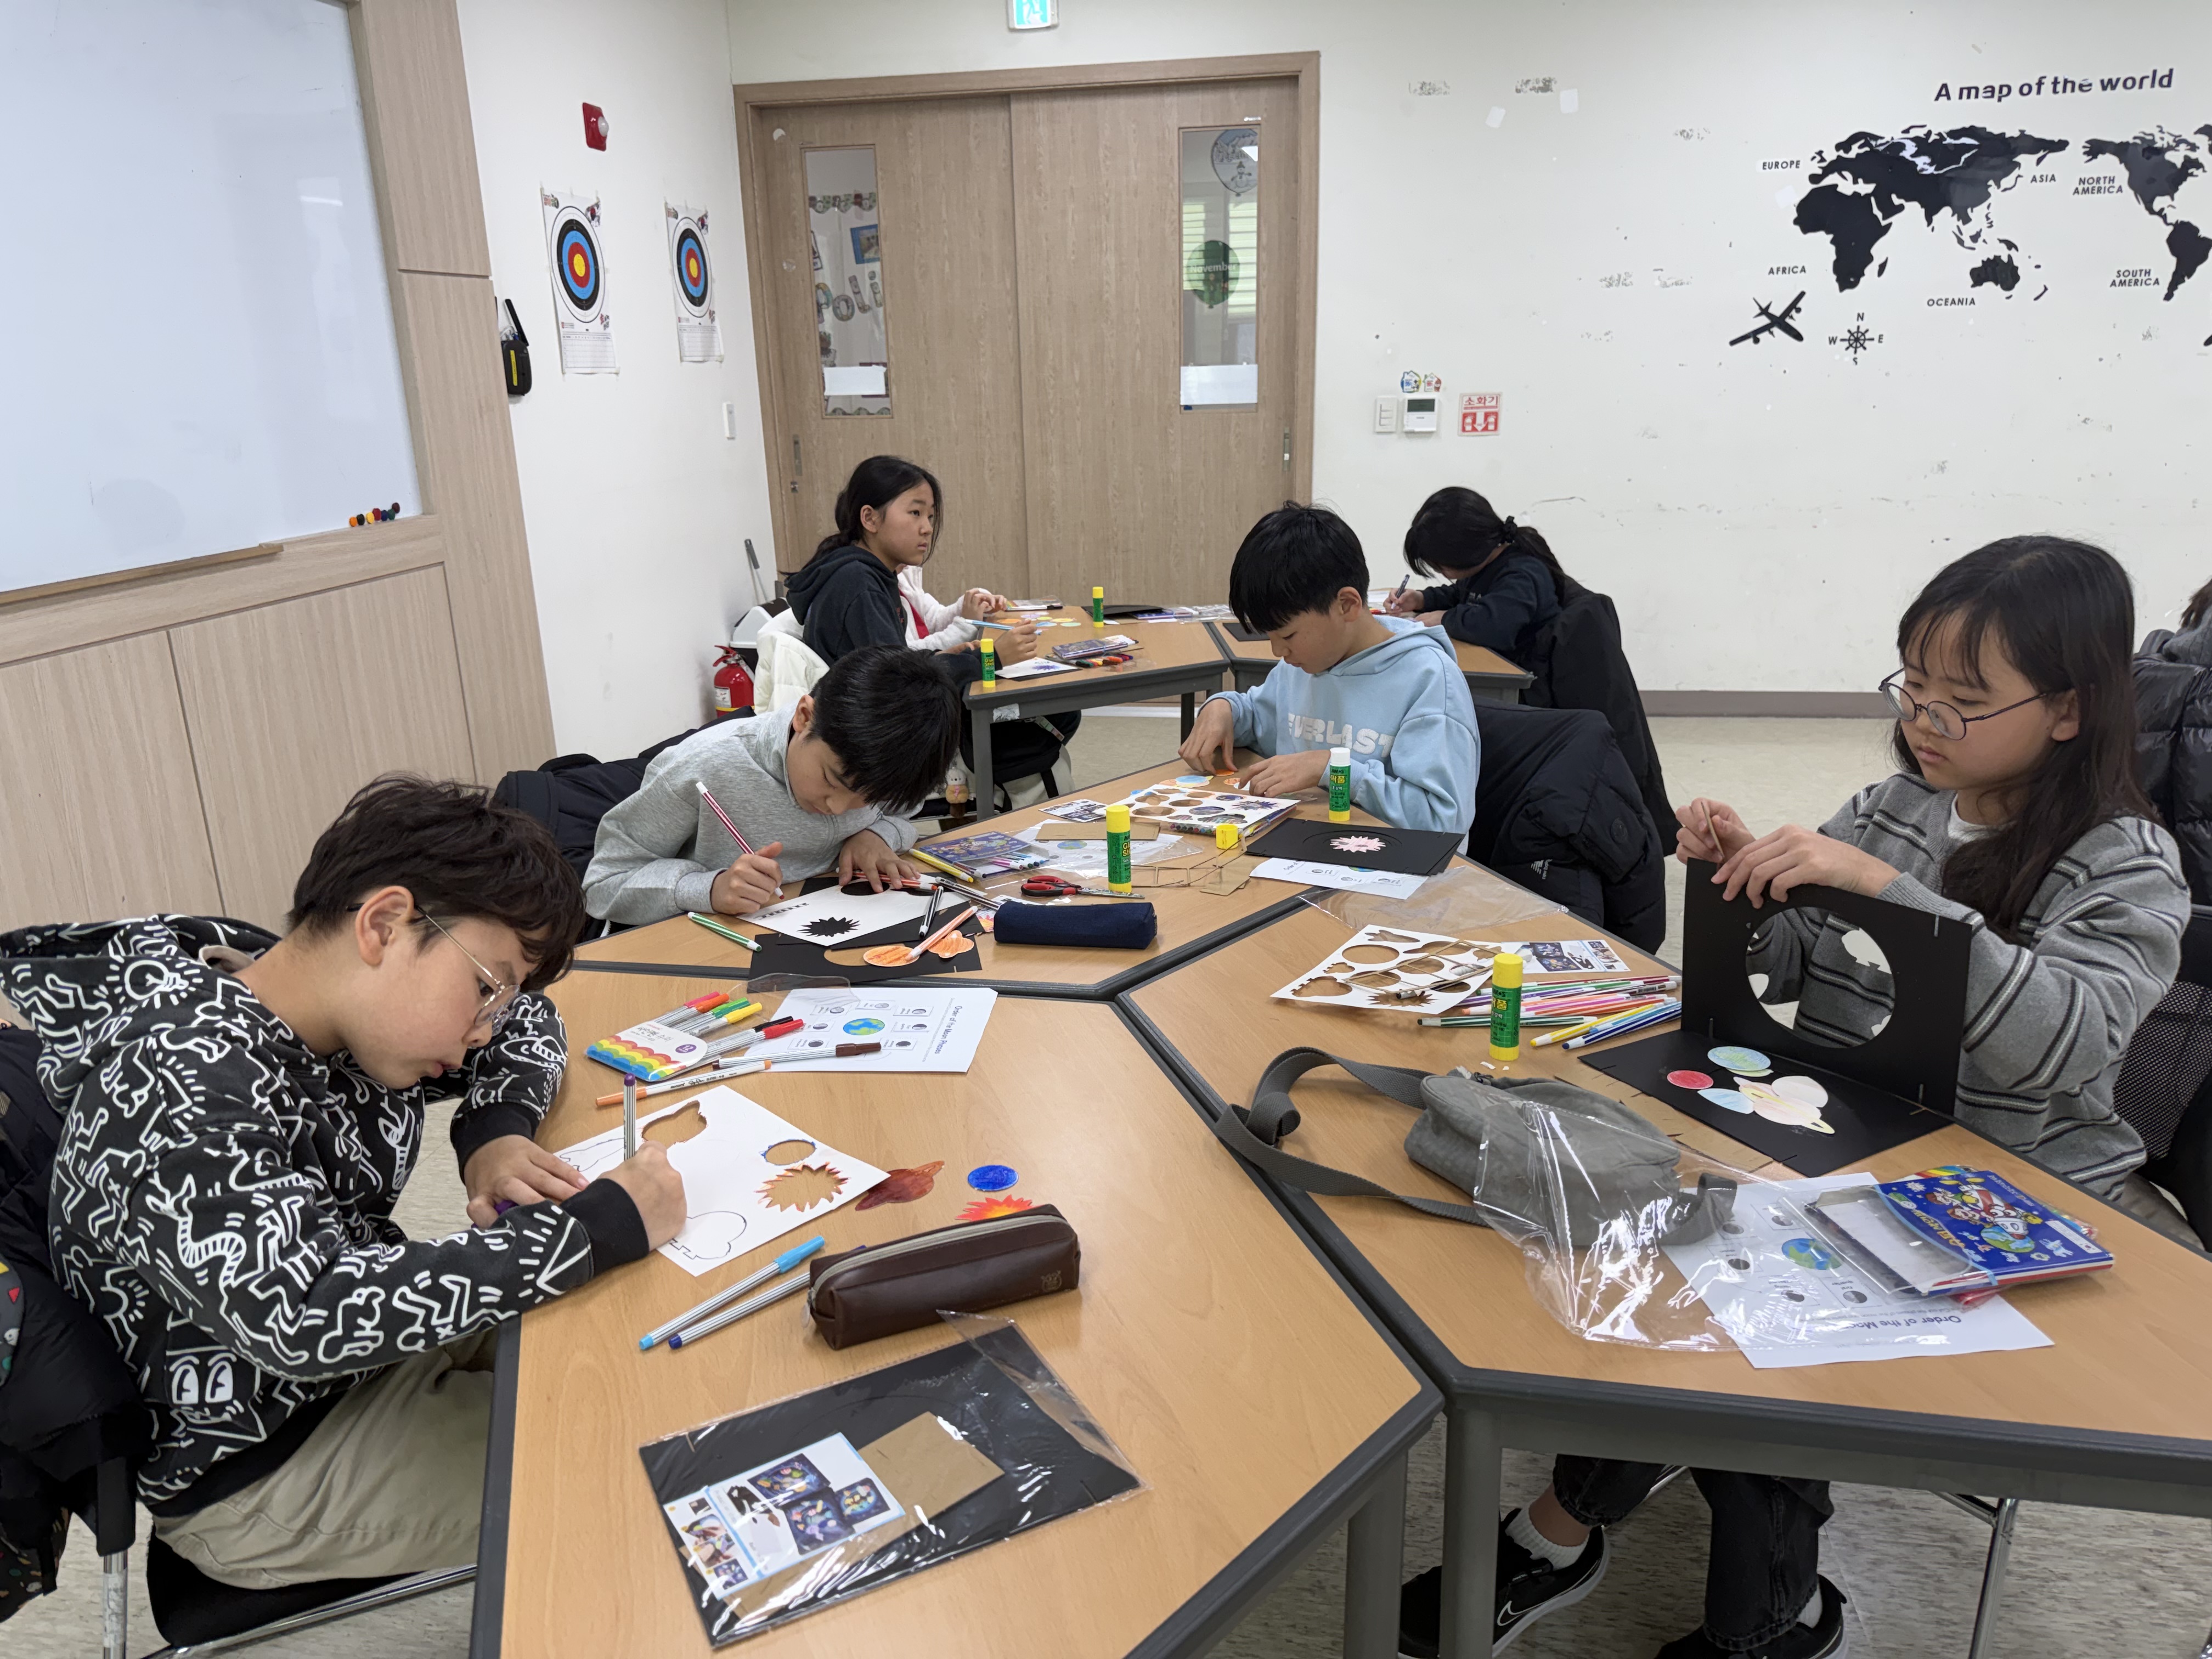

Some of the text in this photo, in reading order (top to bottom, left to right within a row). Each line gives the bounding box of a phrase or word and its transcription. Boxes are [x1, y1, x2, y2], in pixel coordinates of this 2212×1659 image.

[1934, 68, 2174, 103] A map of the world
[1762, 160, 1801, 170] EUROPE
[2030, 173, 2056, 183] ASIA
[2079, 176, 2116, 185] NORTH
[2073, 185, 2123, 195] AMERICA
[1190, 262, 1237, 273] November
[1768, 265, 1807, 275] AFRICA
[2116, 269, 2152, 278] SOUTH
[2110, 278, 2160, 288] AMERICA
[1927, 297, 1976, 307] OCEANIA
[1857, 313, 1864, 321] N
[1828, 336, 1837, 345] W
[1877, 335, 1884, 344] E
[1853, 357, 1858, 366] S
[1463, 396, 1498, 406] 소화기
[952, 1006, 963, 1017] Order
[940, 1029, 953, 1040] Moon
[934, 1040, 948, 1054] Phases
[1880, 1319, 1902, 1328] the
[1903, 1318, 1917, 1327] of
[1922, 1316, 1962, 1324] Order
